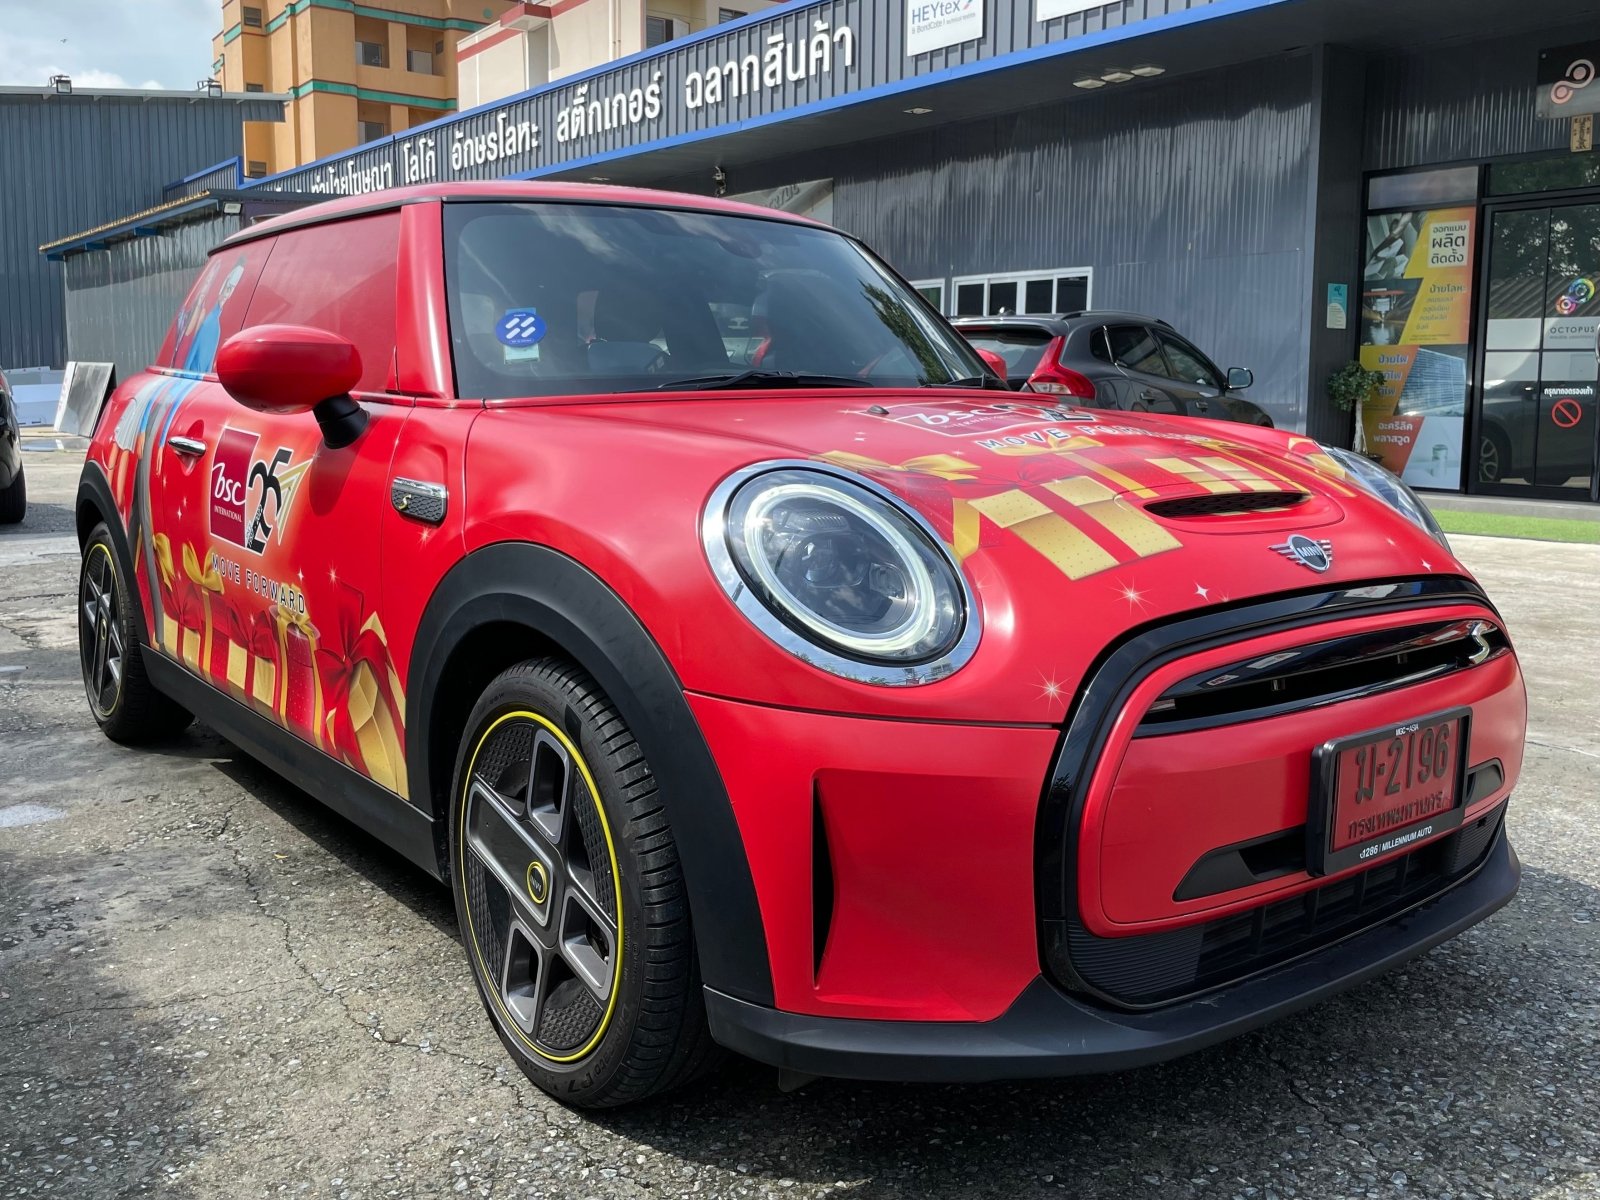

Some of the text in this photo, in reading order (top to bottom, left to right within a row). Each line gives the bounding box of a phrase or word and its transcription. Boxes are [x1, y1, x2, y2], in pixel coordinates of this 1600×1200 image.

[912, 0, 961, 24] HEYtex
[404, 138, 436, 184] โลโก้
[452, 112, 539, 171] อักษรโลหะ
[685, 20, 852, 109] ฉลากสินค้า
[1433, 224, 1467, 233] ออกแบบ
[1432, 233, 1466, 248] ผลิต
[1431, 248, 1464, 264] ติดตั้ง
[1550, 326, 1595, 334] OCTOPUS
[975, 428, 1071, 449] MOVE
[212, 462, 246, 506] bsc
[248, 447, 294, 556] 25
[214, 505, 242, 523] INTERNATIONAL
[1297, 546, 1323, 557] MINI
[212, 553, 305, 614] MOVE FORWARD
[1362, 844, 1378, 858] 1286
[1381, 832, 1417, 852] MILLENNIUM
[1417, 825, 1433, 838] AUTO
